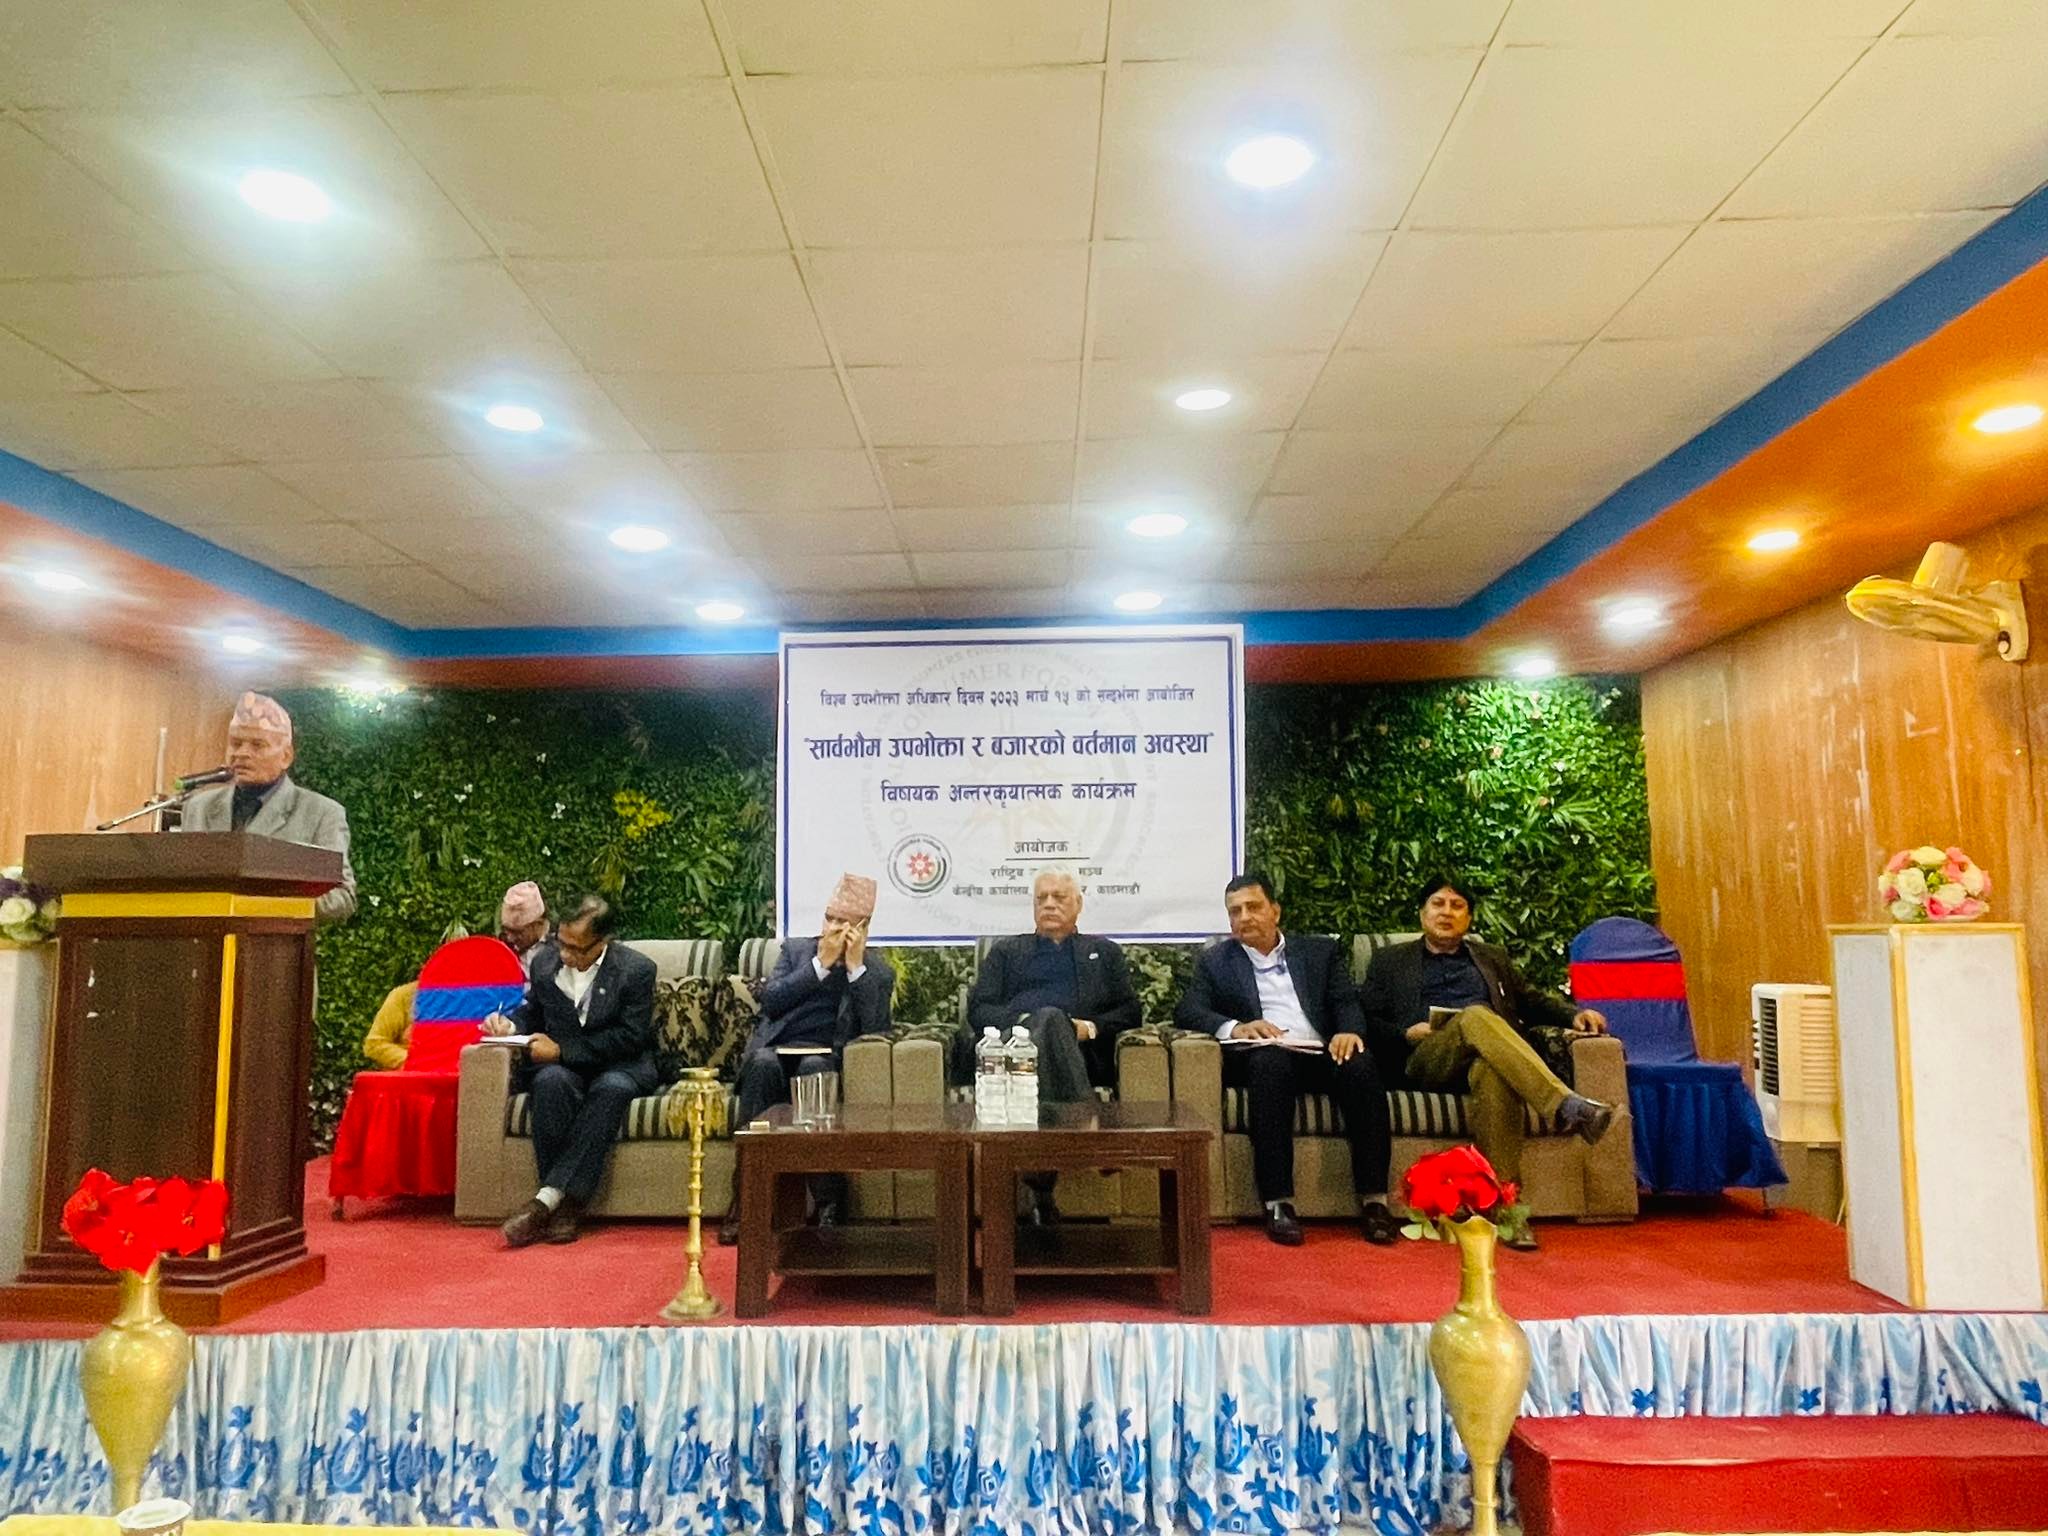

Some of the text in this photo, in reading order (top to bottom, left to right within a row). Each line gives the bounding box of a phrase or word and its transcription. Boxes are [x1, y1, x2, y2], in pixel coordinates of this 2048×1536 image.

[851, 689, 900, 706] उपभोक्ता
[906, 687, 952, 706] अधिकार
[956, 686, 985, 706] दिवस
[989, 690, 1019, 707] २०२३
[1025, 684, 1049, 702] मार्च
[1075, 686, 1091, 702] को
[1145, 683, 1195, 702] आयोजित
[888, 731, 965, 759] उपभोक्ता
[971, 736, 985, 758] र
[991, 729, 1066, 757] बजारको
[1071, 729, 1138, 756] वर्तमान
[880, 778, 942, 803] विषयक
[1070, 776, 1138, 801] कार्यक्रम
[1013, 839, 1070, 854] आयोजक
